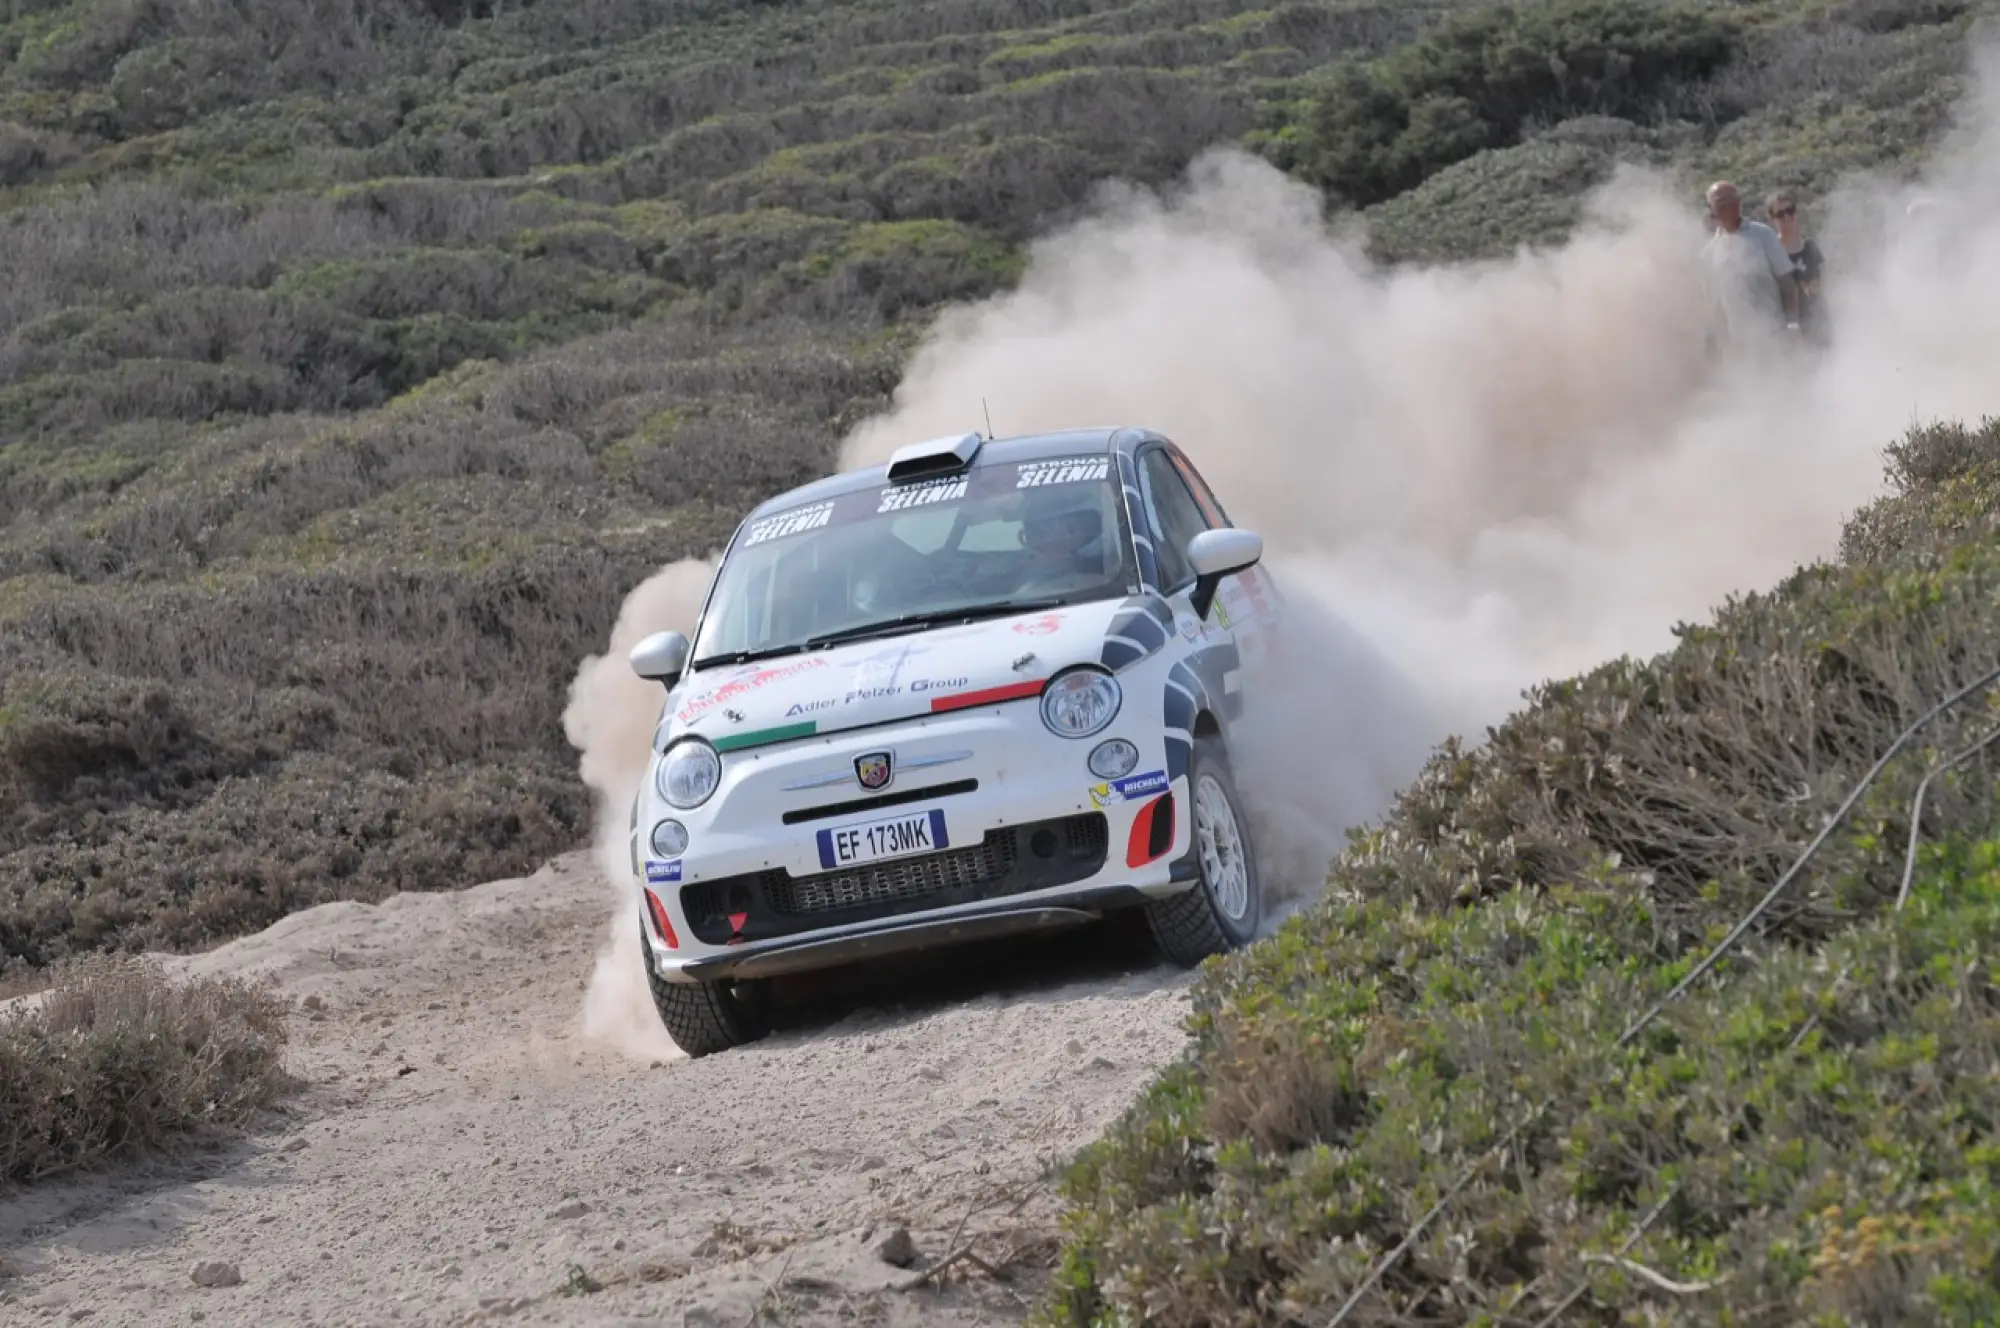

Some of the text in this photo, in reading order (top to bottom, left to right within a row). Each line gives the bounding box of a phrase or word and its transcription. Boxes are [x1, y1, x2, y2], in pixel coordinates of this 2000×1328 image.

[1017, 465, 1109, 488] SELENIA
[877, 481, 968, 513] SELENIA
[744, 508, 832, 547] SELENIA
[785, 700, 836, 717] Adler
[910, 676, 968, 693] Group
[1124, 775, 1166, 793] MICHELIN
[836, 818, 930, 861] EF 173MK
